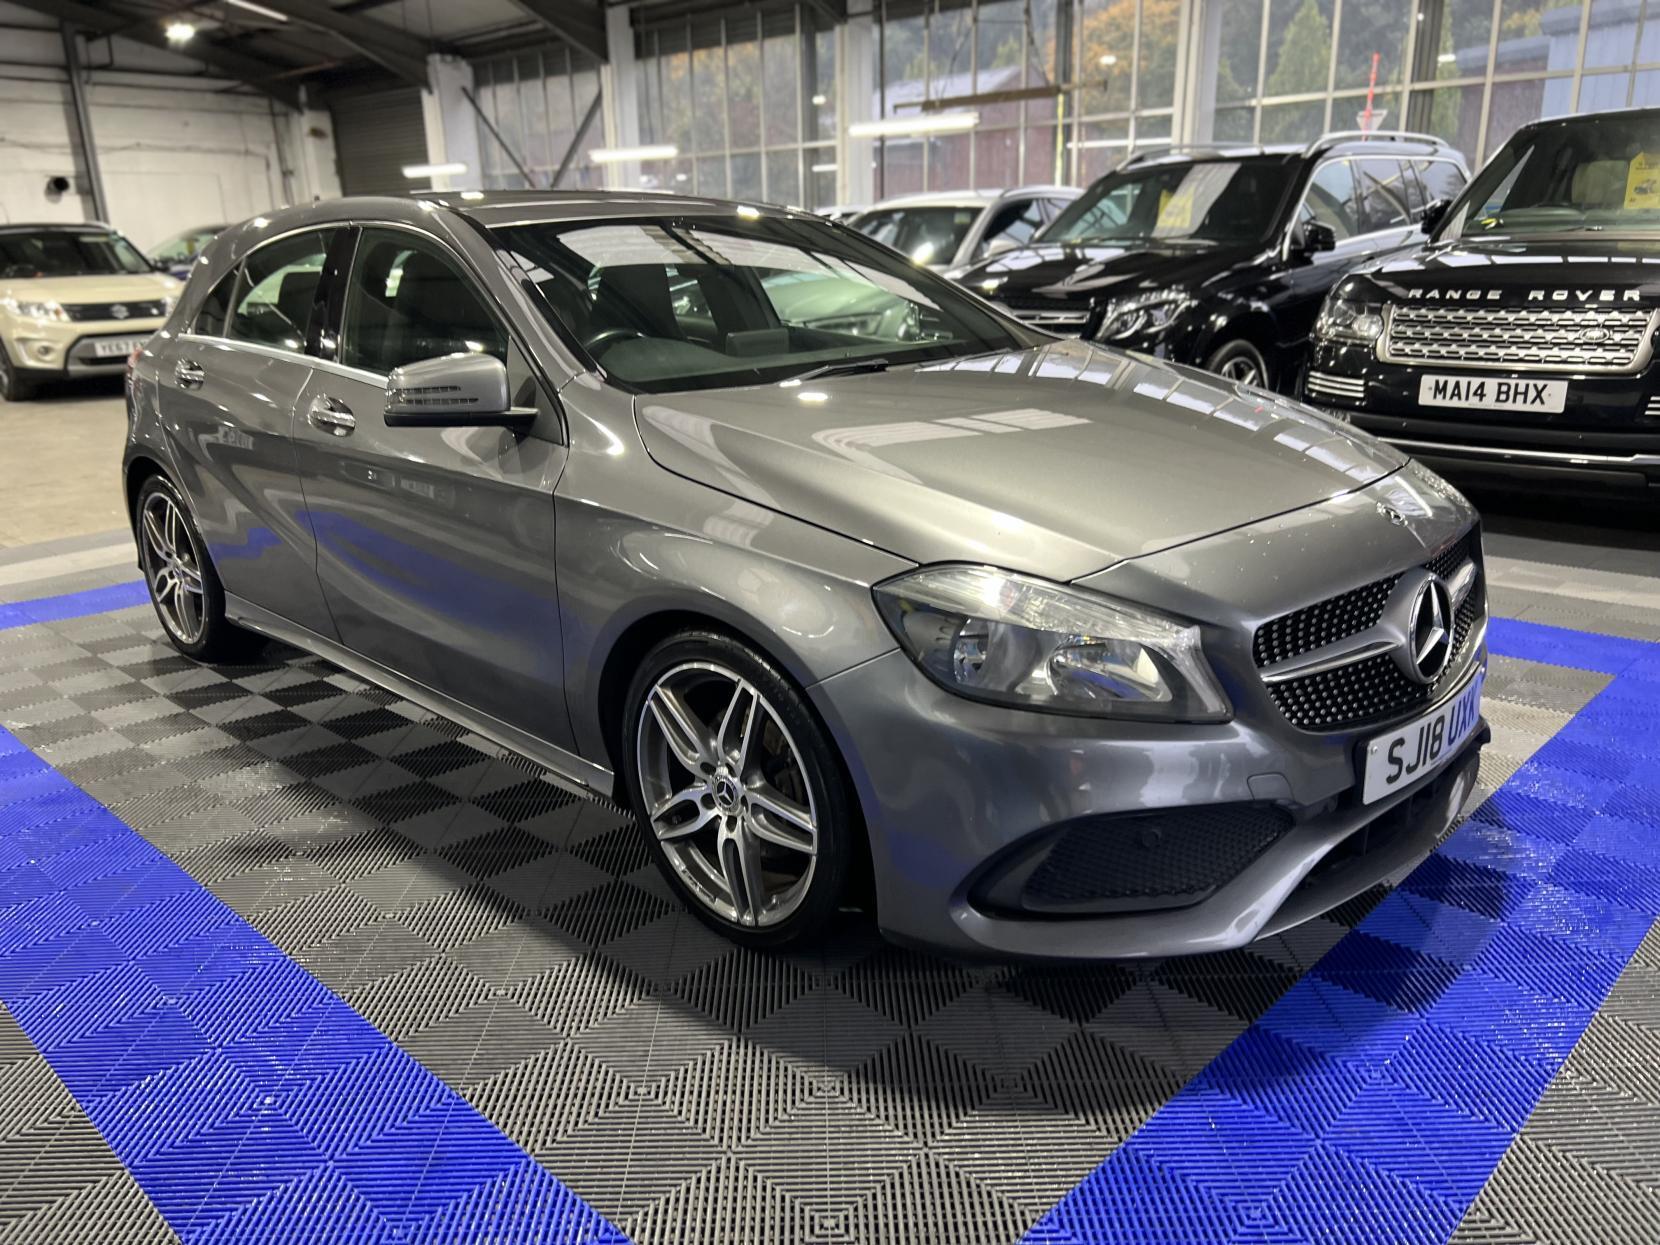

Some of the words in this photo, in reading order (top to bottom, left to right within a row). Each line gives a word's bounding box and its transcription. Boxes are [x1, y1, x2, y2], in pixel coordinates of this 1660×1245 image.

[1408, 288, 1502, 300] RANGE
[1527, 289, 1641, 301] ROVER
[1432, 379, 1487, 403] MA14
[1494, 381, 1549, 406] BHX
[1385, 714, 1446, 785] SJ18
